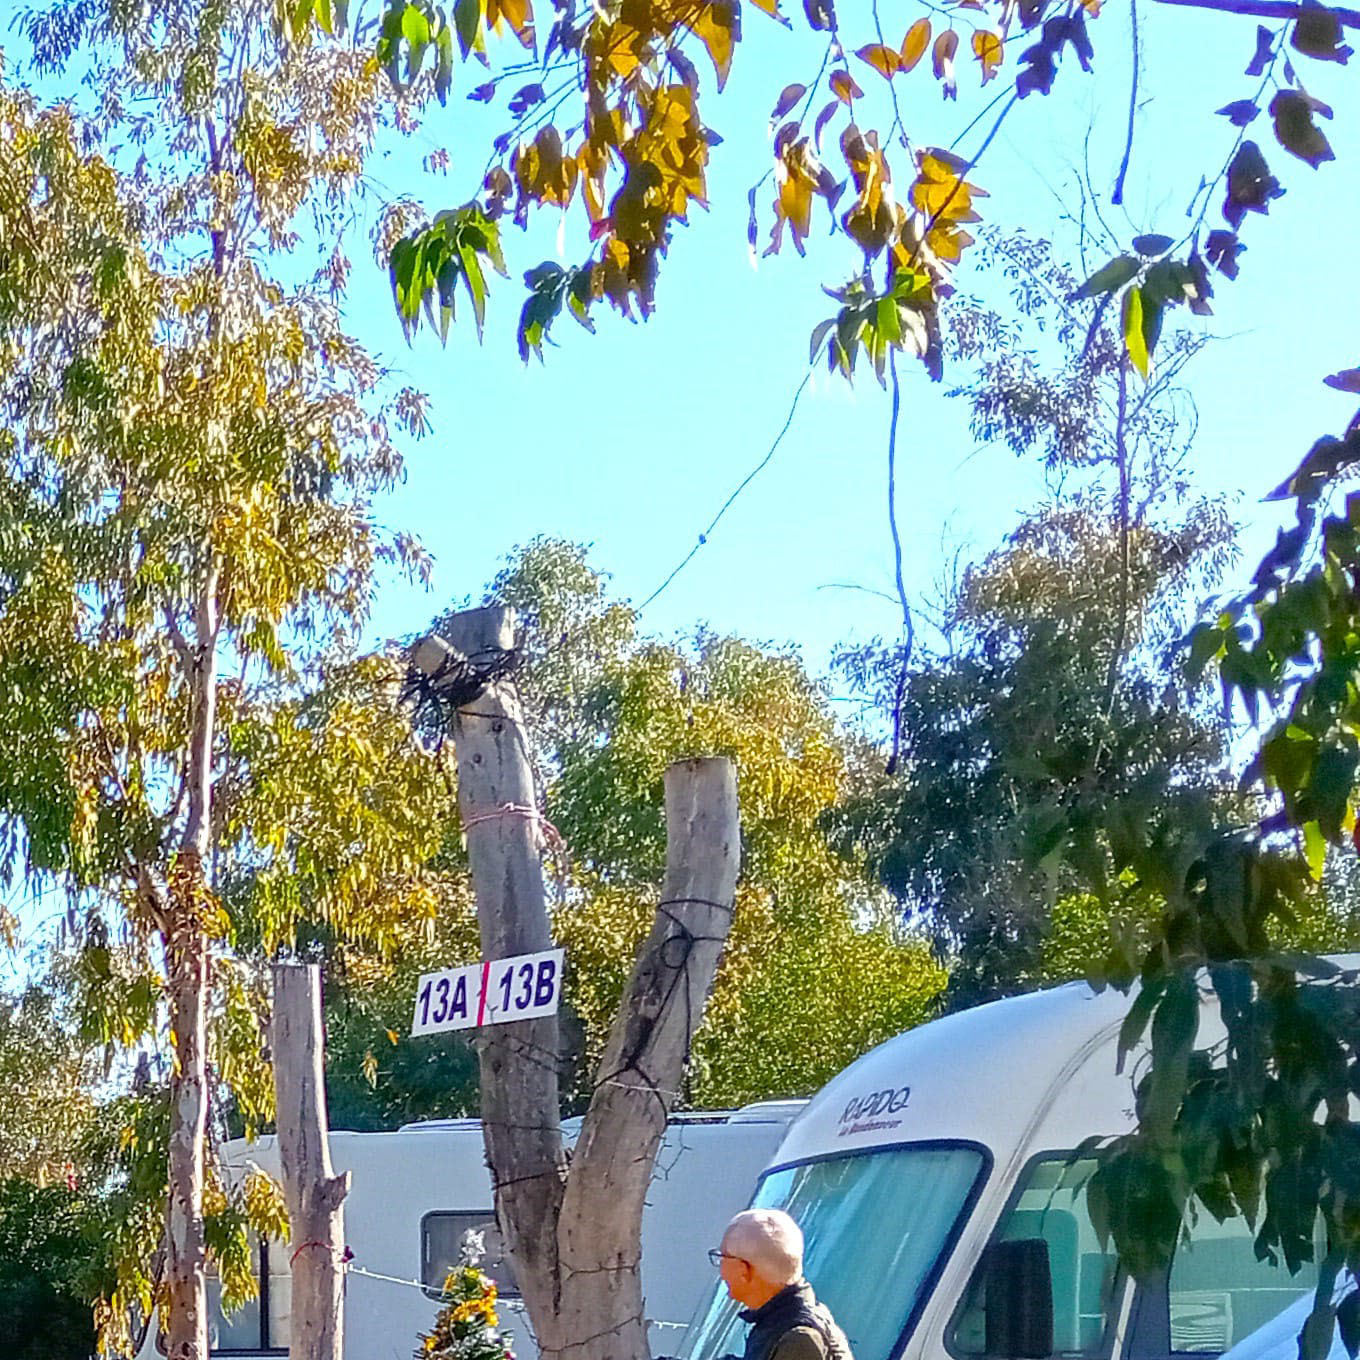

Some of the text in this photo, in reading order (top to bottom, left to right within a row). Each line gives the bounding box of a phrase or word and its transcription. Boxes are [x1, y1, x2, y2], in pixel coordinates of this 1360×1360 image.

[419, 960, 555, 1025] 13A 13B
[838, 1086, 910, 1125] RAPIDO
